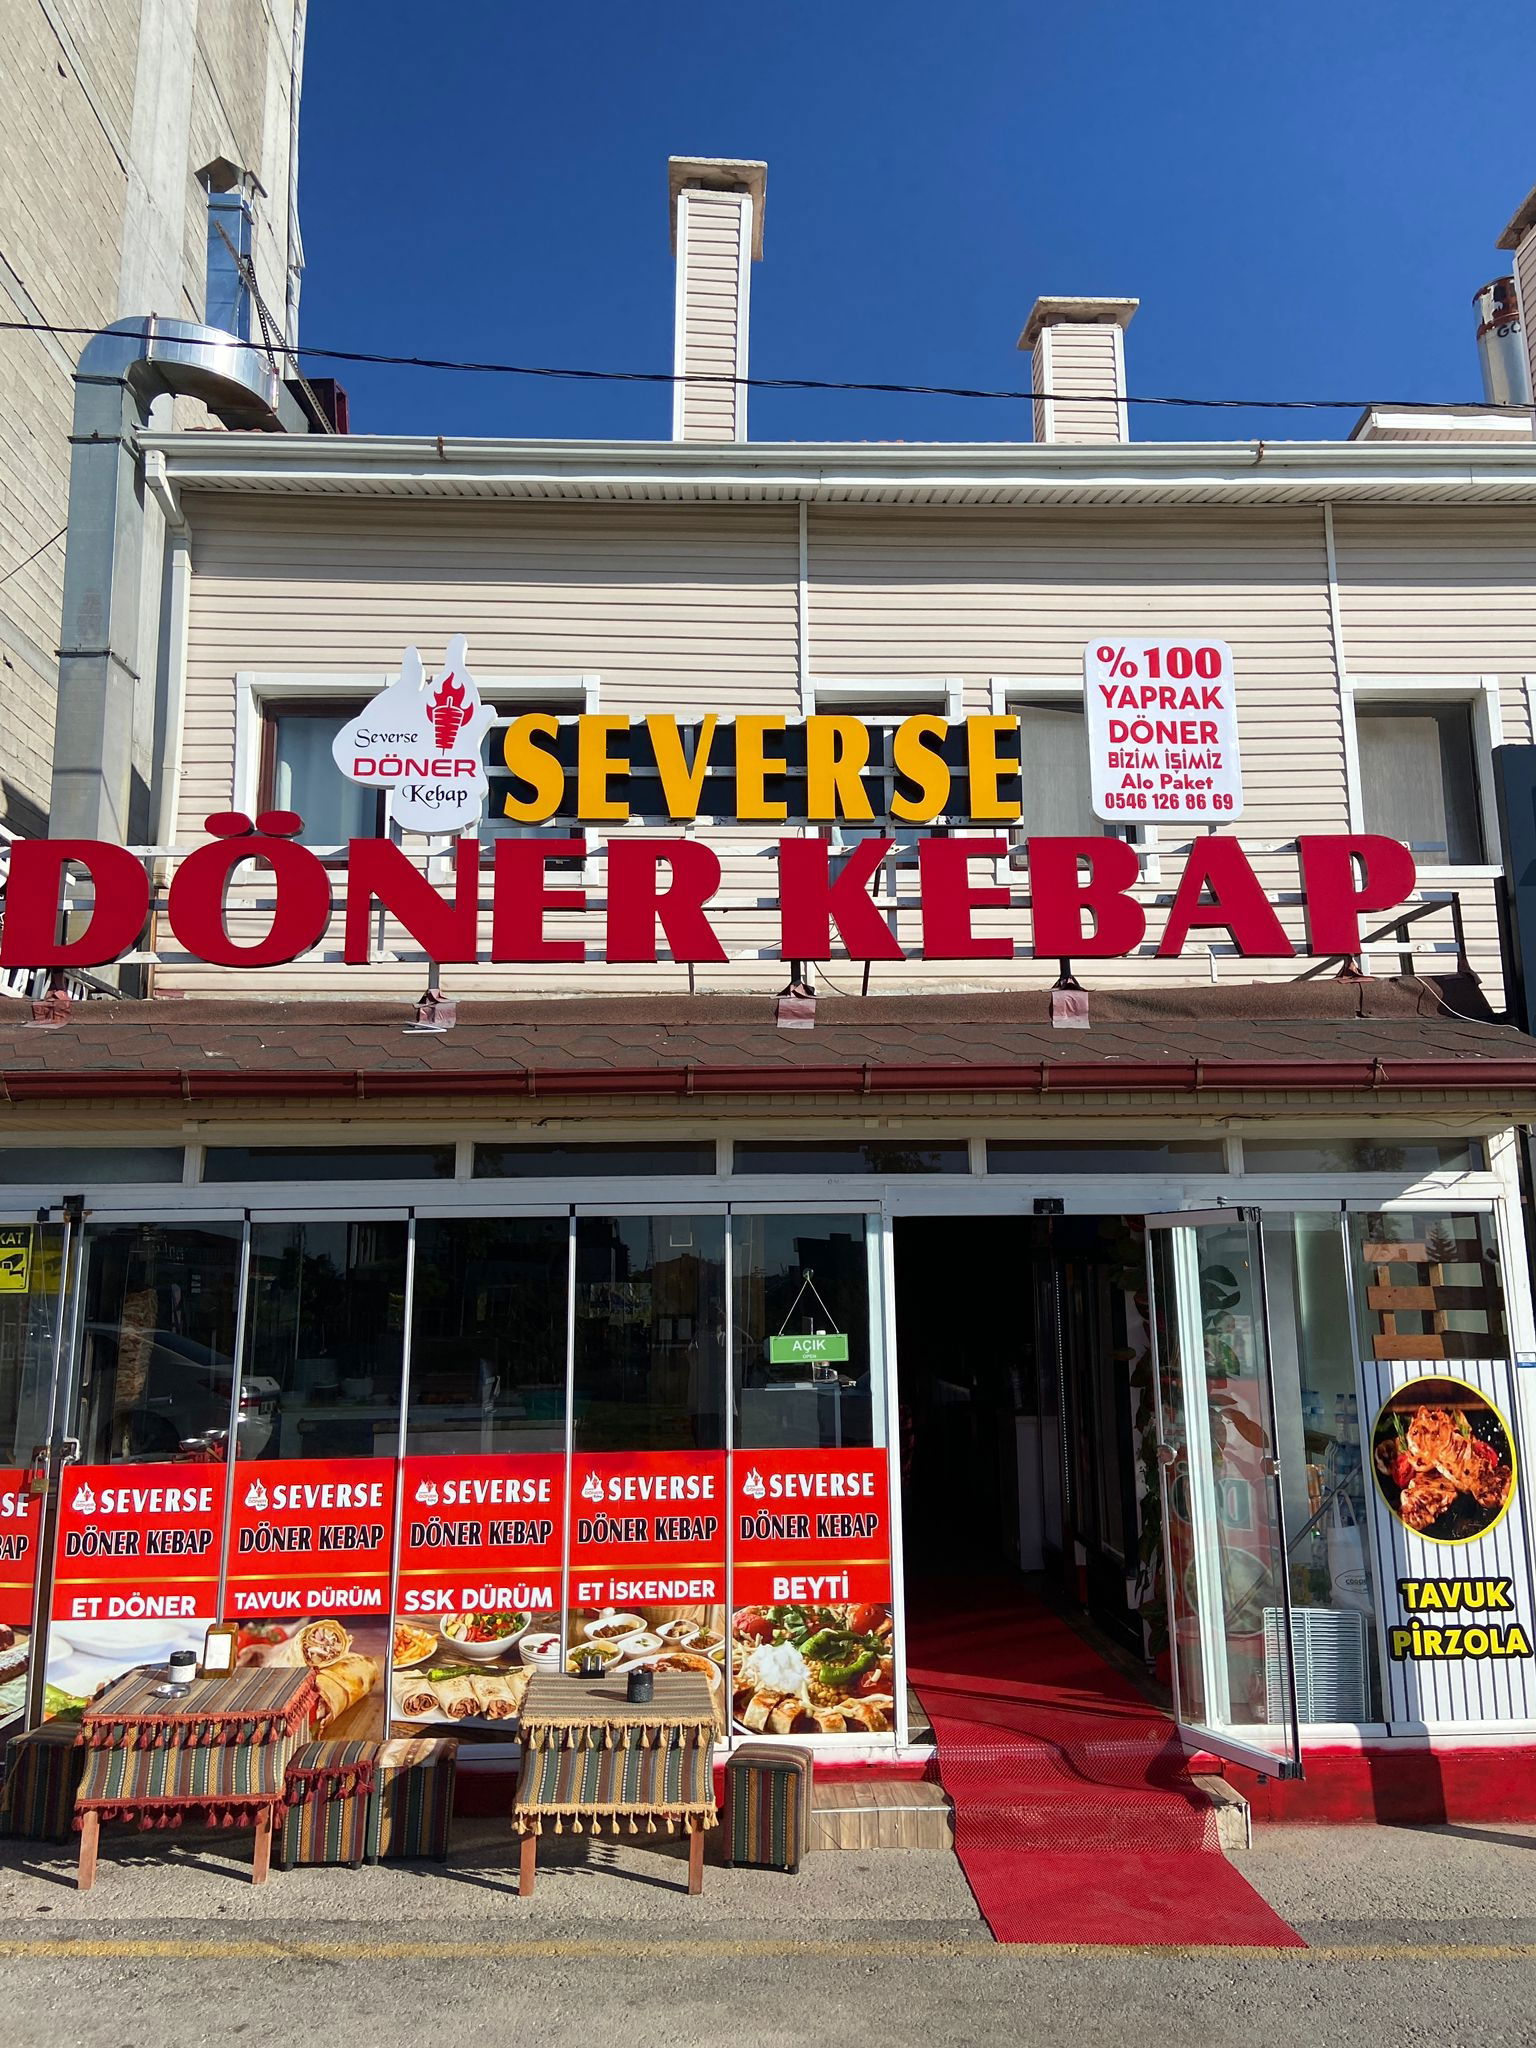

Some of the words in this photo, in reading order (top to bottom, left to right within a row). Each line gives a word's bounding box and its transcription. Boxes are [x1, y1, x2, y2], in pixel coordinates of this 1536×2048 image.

[1098, 685, 1224, 710] YAPRAK
[354, 728, 419, 748] Severse
[1109, 714, 1219, 744] DÖNER
[353, 754, 476, 777] DÖNER
[503, 712, 1022, 823] SEVERSE
[1108, 747, 1159, 769] BİZİM
[1165, 748, 1222, 774] İŞİMİZ
[1120, 773, 1154, 789] Alo
[1160, 774, 1213, 790] Paket
[402, 784, 468, 809] Kebap
[1105, 792, 1147, 809] 0546
[1152, 793, 1180, 809] 126
[1185, 793, 1207, 809] 86
[1212, 793, 1233, 810] 69
[0, 810, 729, 968] DÖNER
[779, 833, 1417, 962] KEBAP
[792, 1339, 826, 1353] AÇIK
[272, 1482, 384, 1510] SEVERSE
[442, 1478, 551, 1505] SEVERSE
[608, 1475, 715, 1502] SEVERSE
[769, 1472, 875, 1498] SEVERSE
[99, 1487, 213, 1514] SEVERSE
[239, 1520, 312, 1554] DÖNER
[318, 1523, 384, 1551] KEBAP
[409, 1517, 482, 1548] DÖNER
[488, 1519, 553, 1546] KEBAP
[577, 1513, 649, 1544] DÖNER
[654, 1516, 718, 1542] KEBAP
[739, 1508, 810, 1540] DÖNER
[816, 1512, 880, 1538] KEBAP
[65, 1525, 139, 1557] DÖNER
[145, 1528, 213, 1555] KEBAP
[234, 1590, 302, 1610] TAVUK
[306, 1585, 382, 1608] DÜRÜM
[404, 1589, 456, 1612] SSK
[461, 1582, 553, 1609] DÜRÜM
[578, 1582, 605, 1601] ET
[609, 1577, 716, 1600] İSKENDER
[772, 1569, 850, 1600] BEYTİ
[1400, 1580, 1512, 1610] TAVUK
[72, 1597, 102, 1618] ET
[108, 1592, 195, 1617] DÖNER
[1392, 1622, 1531, 1657] PİRZOLA
